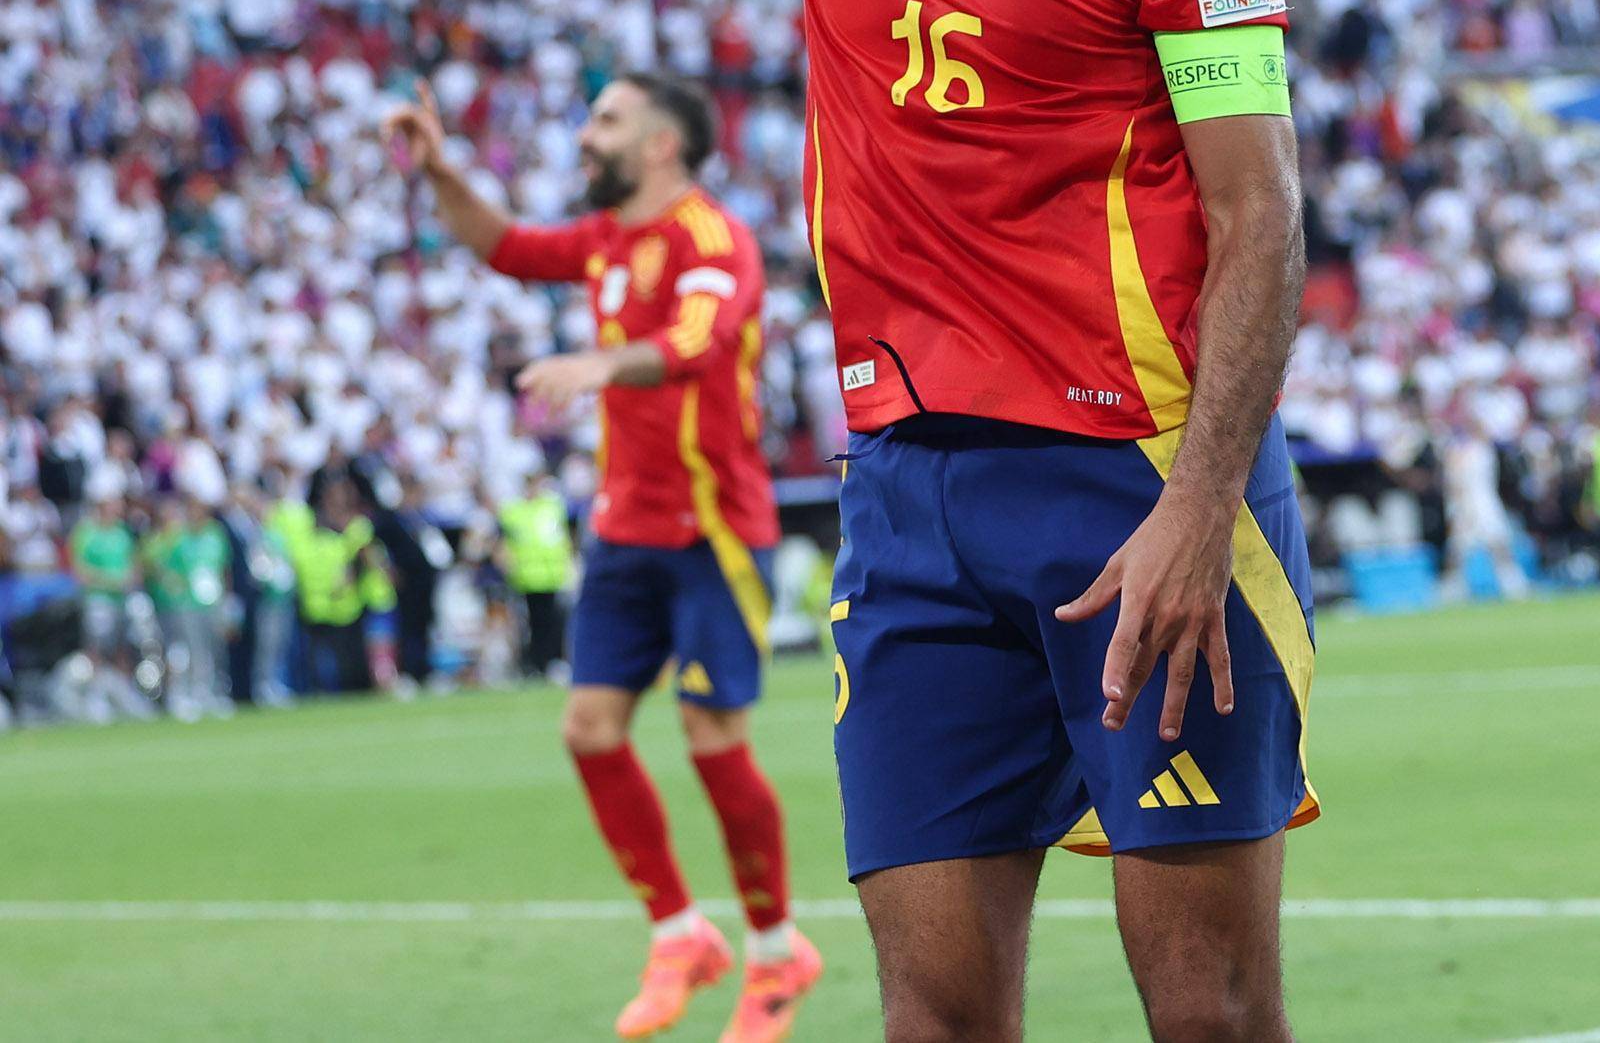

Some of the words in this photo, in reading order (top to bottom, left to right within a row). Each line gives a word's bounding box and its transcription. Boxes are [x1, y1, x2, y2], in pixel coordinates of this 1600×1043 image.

[891, 0, 985, 113] 16
[1167, 62, 1240, 88] RESPECT
[1067, 386, 1122, 406] HEAT.RDY
